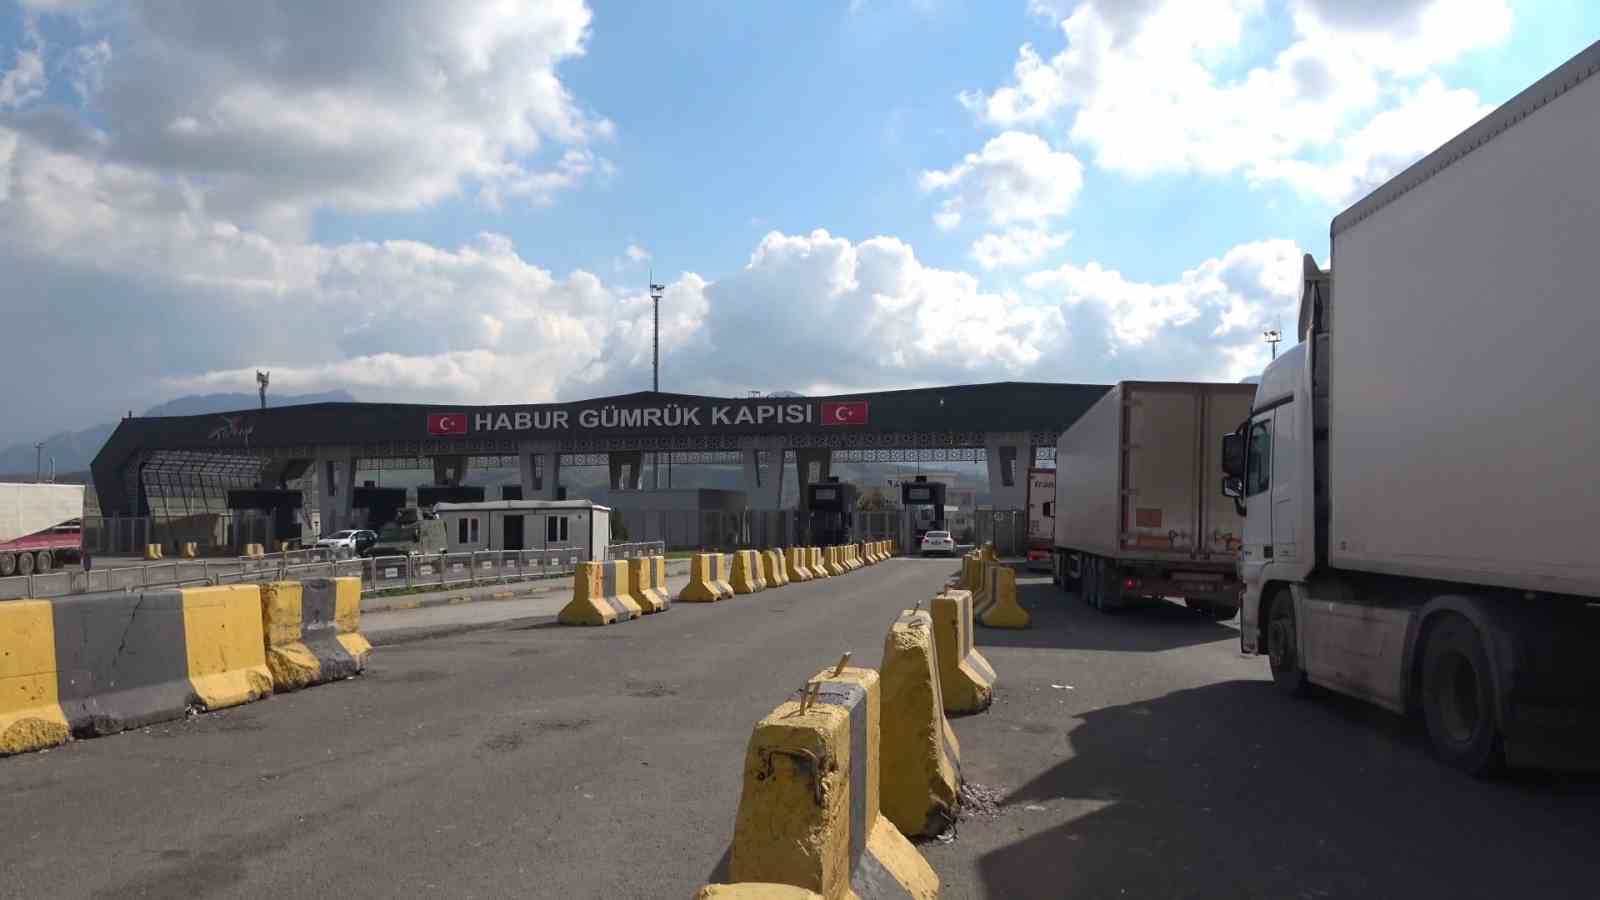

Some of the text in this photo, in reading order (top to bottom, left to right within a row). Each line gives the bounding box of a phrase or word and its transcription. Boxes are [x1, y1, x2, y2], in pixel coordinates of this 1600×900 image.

[475, 404, 813, 431] HABUR GÜMRÜK KAPISI
